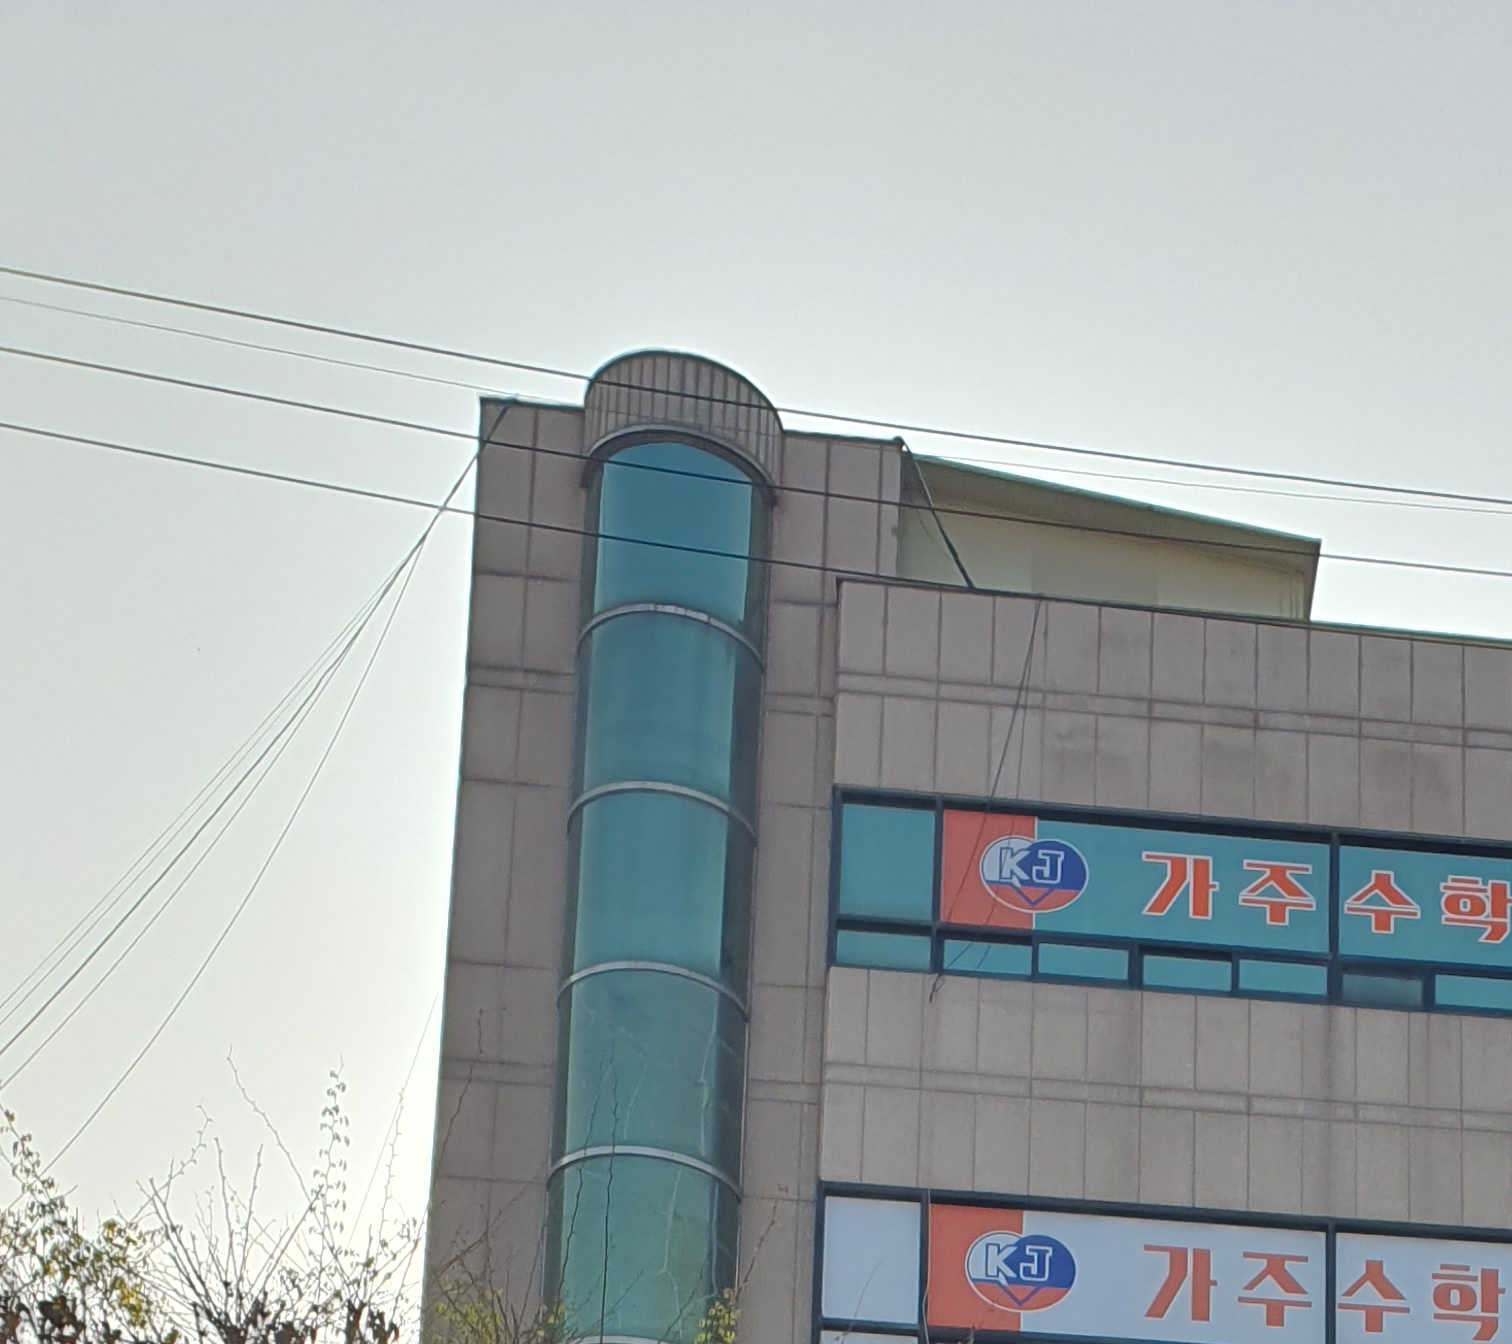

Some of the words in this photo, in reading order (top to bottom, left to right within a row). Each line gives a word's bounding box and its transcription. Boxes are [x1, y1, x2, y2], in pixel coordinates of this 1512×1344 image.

[998, 845, 1065, 886] KJ
[977, 1241, 1056, 1284] KJ
[1142, 1242, 1508, 1343] 가주수학
